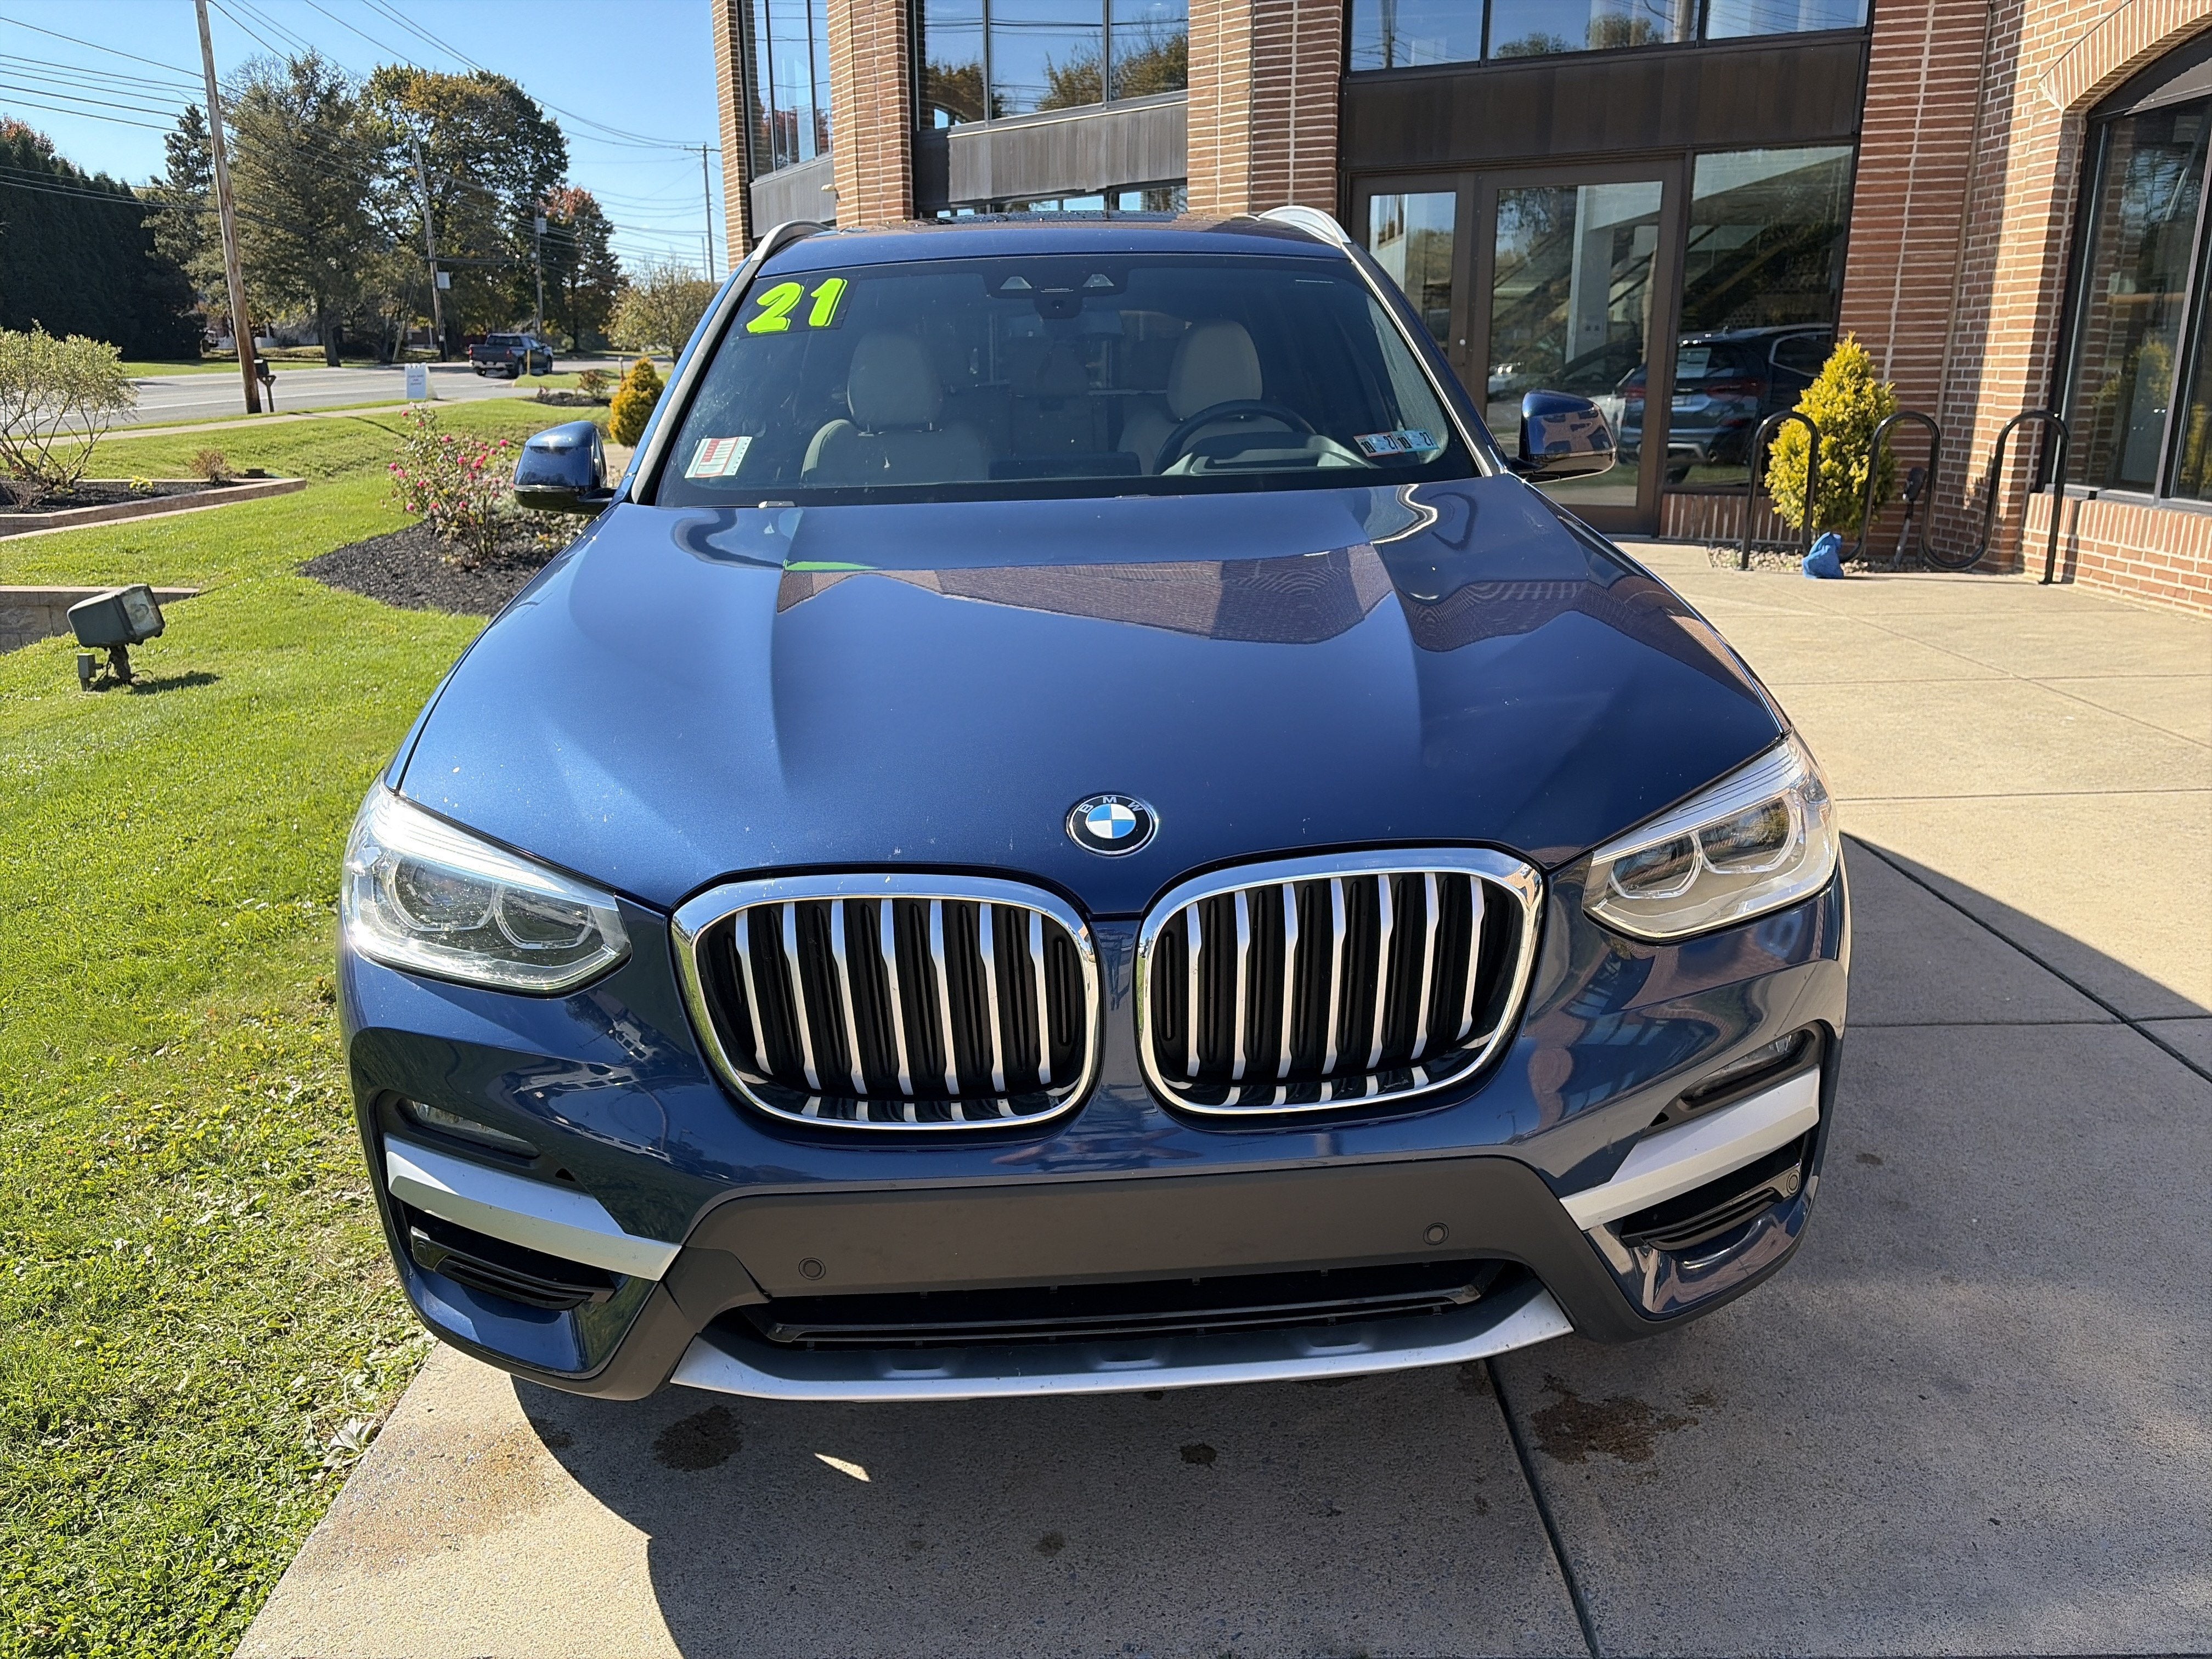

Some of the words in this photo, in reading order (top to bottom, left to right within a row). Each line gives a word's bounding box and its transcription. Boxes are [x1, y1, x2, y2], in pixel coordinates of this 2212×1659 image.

[747, 278, 848, 333] 21
[1361, 441, 1376, 453] 10
[1383, 435, 1398, 450] 27
[1397, 437, 1412, 449] 10
[1419, 432, 1434, 446] 27
[1077, 797, 1144, 813] BMW
